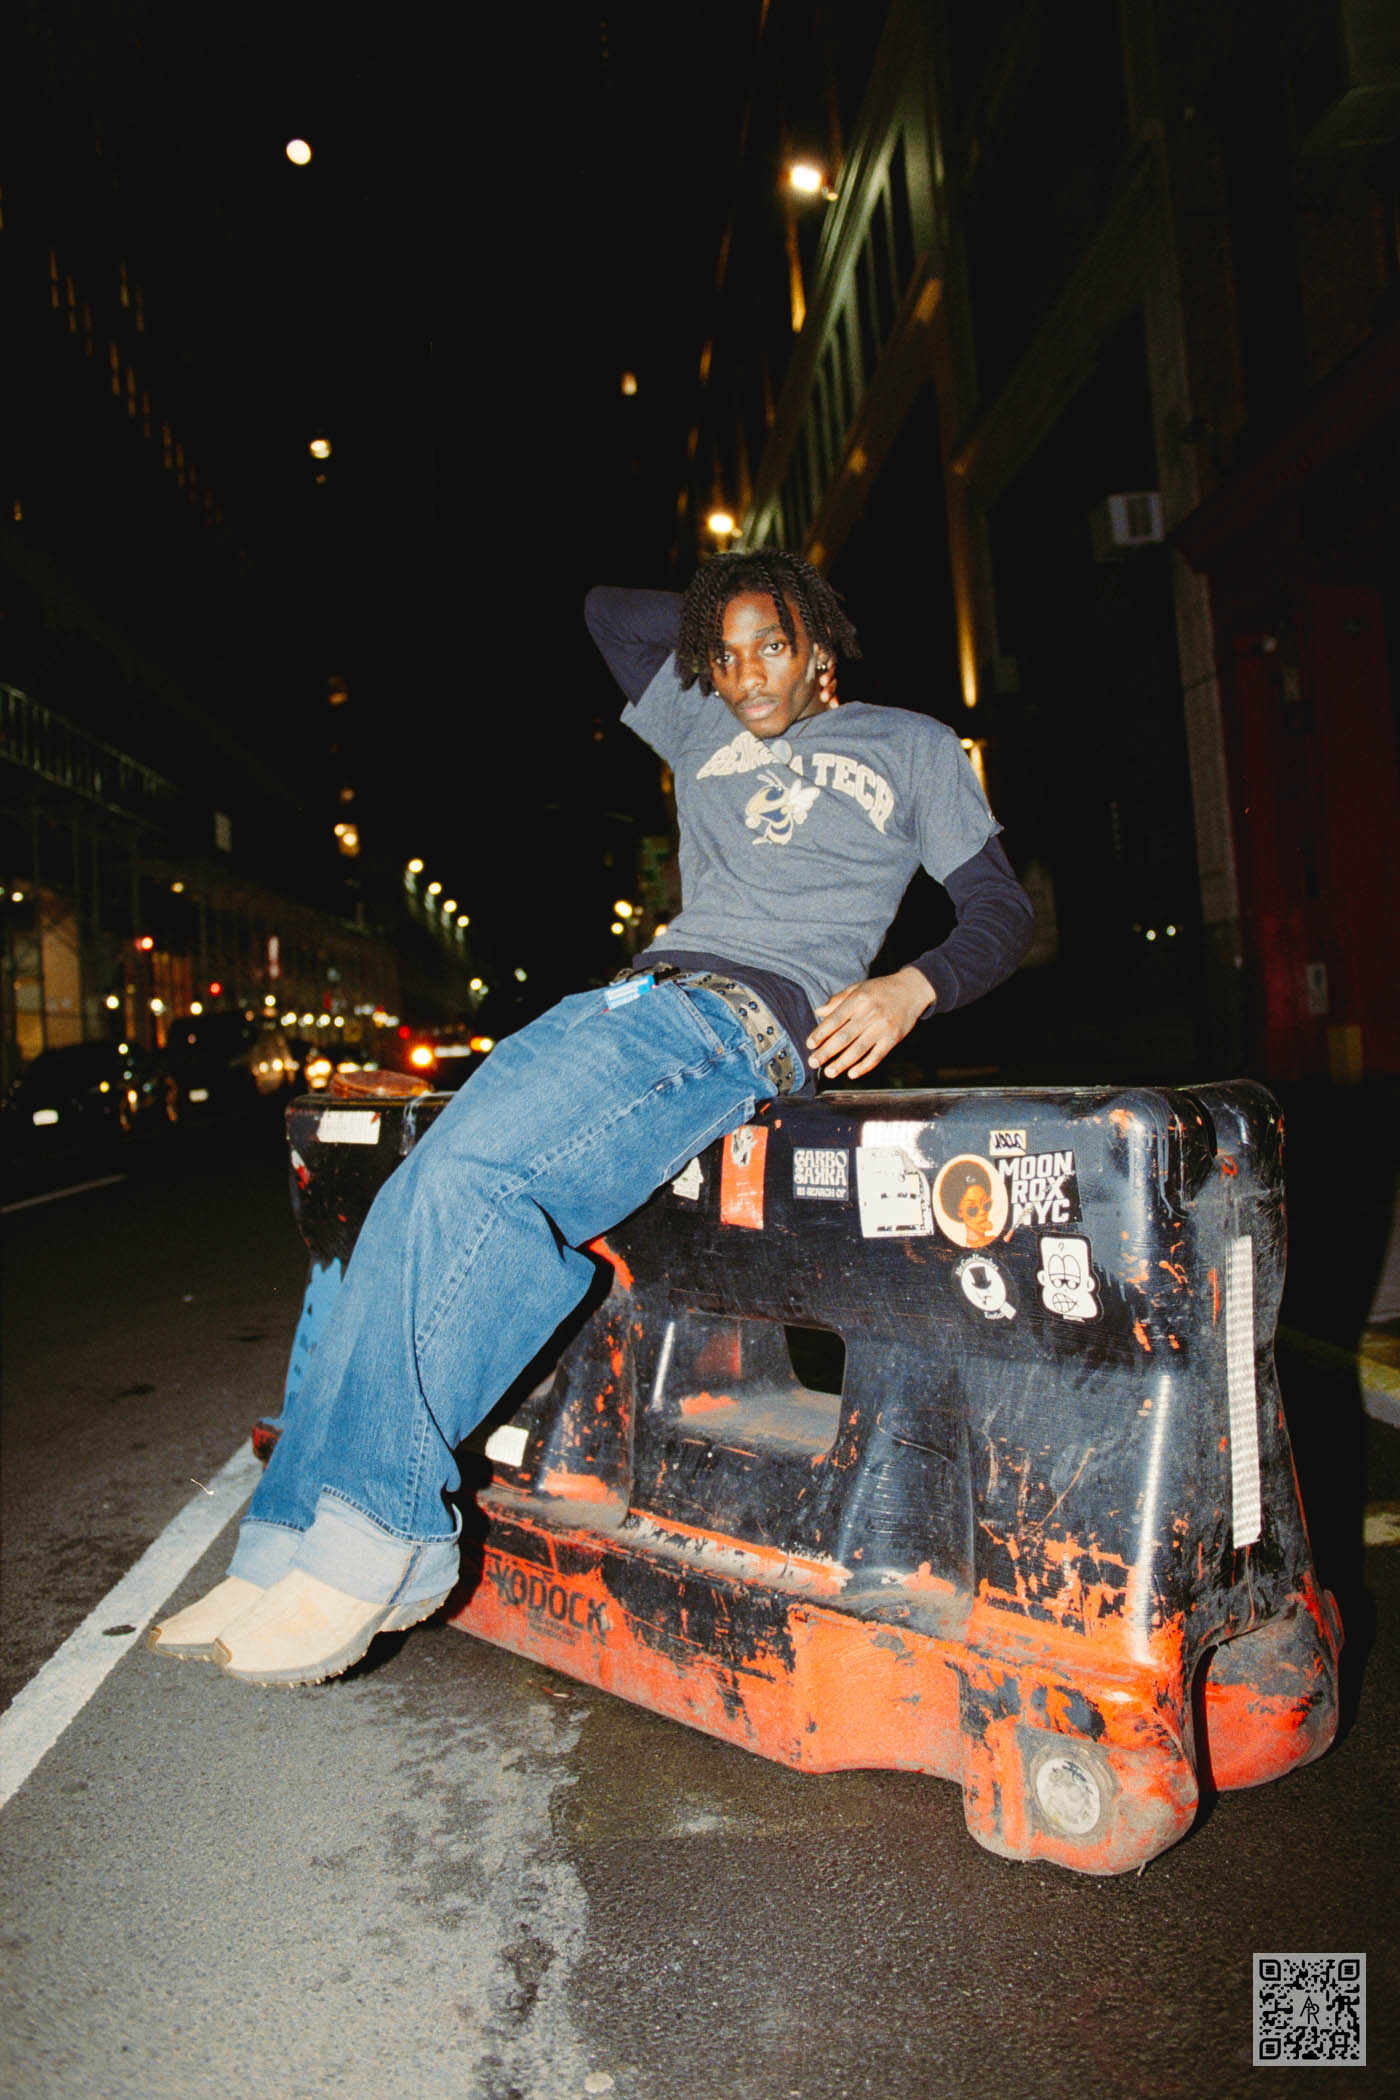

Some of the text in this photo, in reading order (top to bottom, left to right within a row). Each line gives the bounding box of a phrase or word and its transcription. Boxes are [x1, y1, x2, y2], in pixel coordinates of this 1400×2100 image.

[998, 1151, 1075, 1181] MOON
[1011, 1176, 1066, 1204] ROX
[1012, 1198, 1071, 1226] NYC
